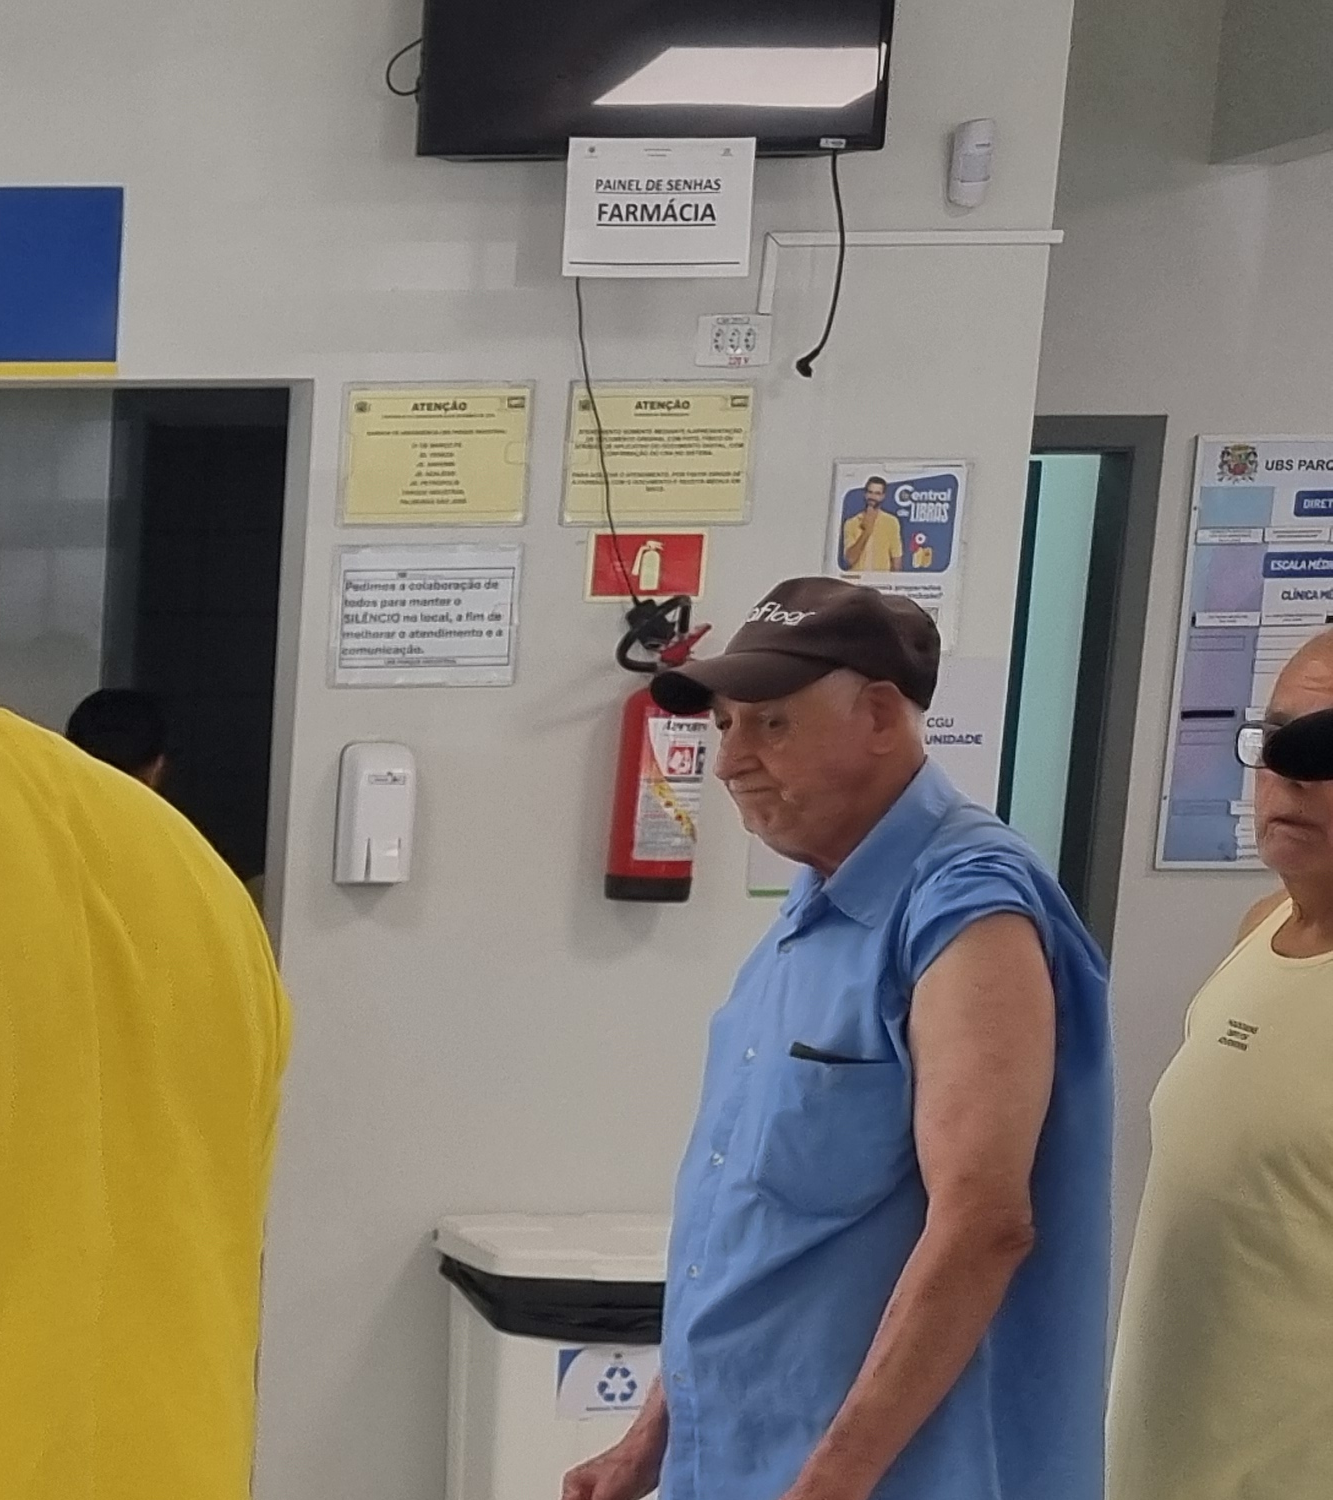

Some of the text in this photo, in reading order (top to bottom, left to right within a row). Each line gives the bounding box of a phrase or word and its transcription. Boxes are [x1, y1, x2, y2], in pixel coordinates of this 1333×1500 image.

[595, 178, 721, 191] PAINEL DE SENHAS
[597, 198, 716, 222] FARMÁCIA
[411, 401, 467, 413] ATENÇÃO
[634, 400, 691, 412] ATENÇÃO
[1265, 460, 1293, 471] UBS
[895, 484, 952, 506] Central
[910, 502, 949, 523] LIBRAS
[1270, 559, 1305, 571] ESCALA
[408, 579, 481, 592] colaboração
[484, 578, 499, 590] de
[1281, 587, 1318, 600] CLÍNICA
[380, 599, 406, 609] para
[409, 598, 451, 607] manter
[344, 612, 400, 624] SILÊNCIO
[465, 613, 485, 621] fim
[487, 613, 502, 621] de
[342, 630, 396, 639] melhorar
[408, 629, 483, 638] atendimento
[927, 717, 954, 728] CGU
